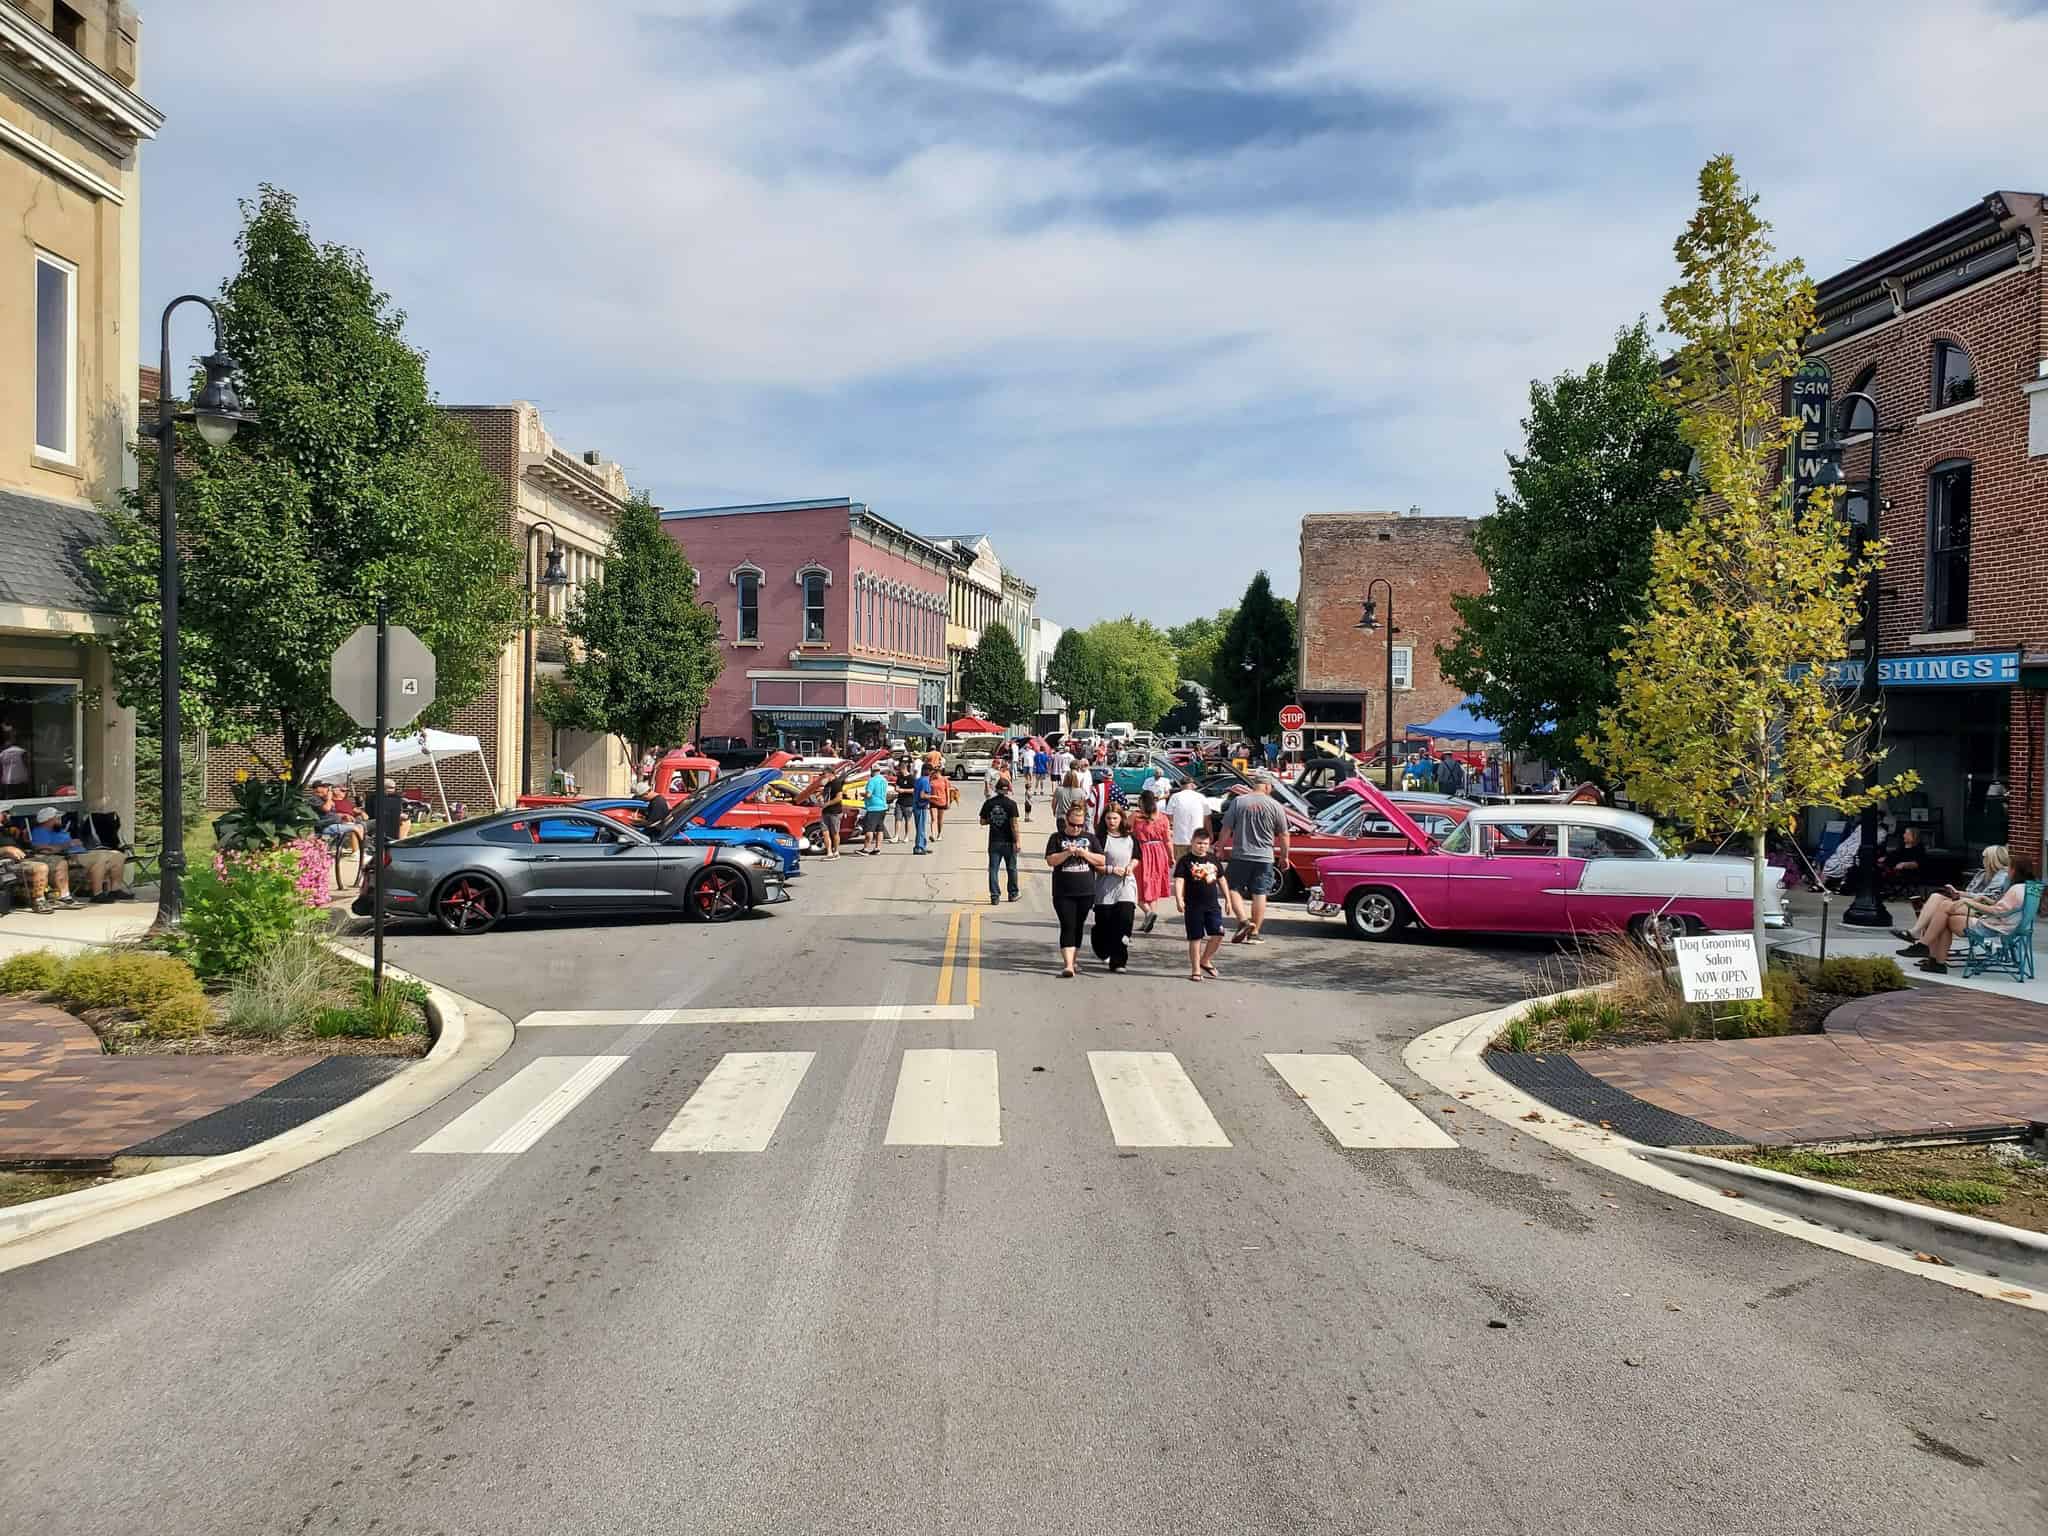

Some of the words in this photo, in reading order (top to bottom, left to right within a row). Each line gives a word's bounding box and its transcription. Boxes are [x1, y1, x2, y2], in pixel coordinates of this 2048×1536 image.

[1793, 381, 1829, 395] SAM
[1794, 658, 1993, 684] FRNSHINGS
[404, 680, 415, 693] 4
[1281, 713, 1303, 723] STOP
[1679, 939, 1699, 952] Dog
[1701, 937, 1751, 951] Grooming
[1705, 953, 1733, 966] Salon
[1695, 971, 1718, 983] NOW
[1721, 969, 1748, 983] OPEN
